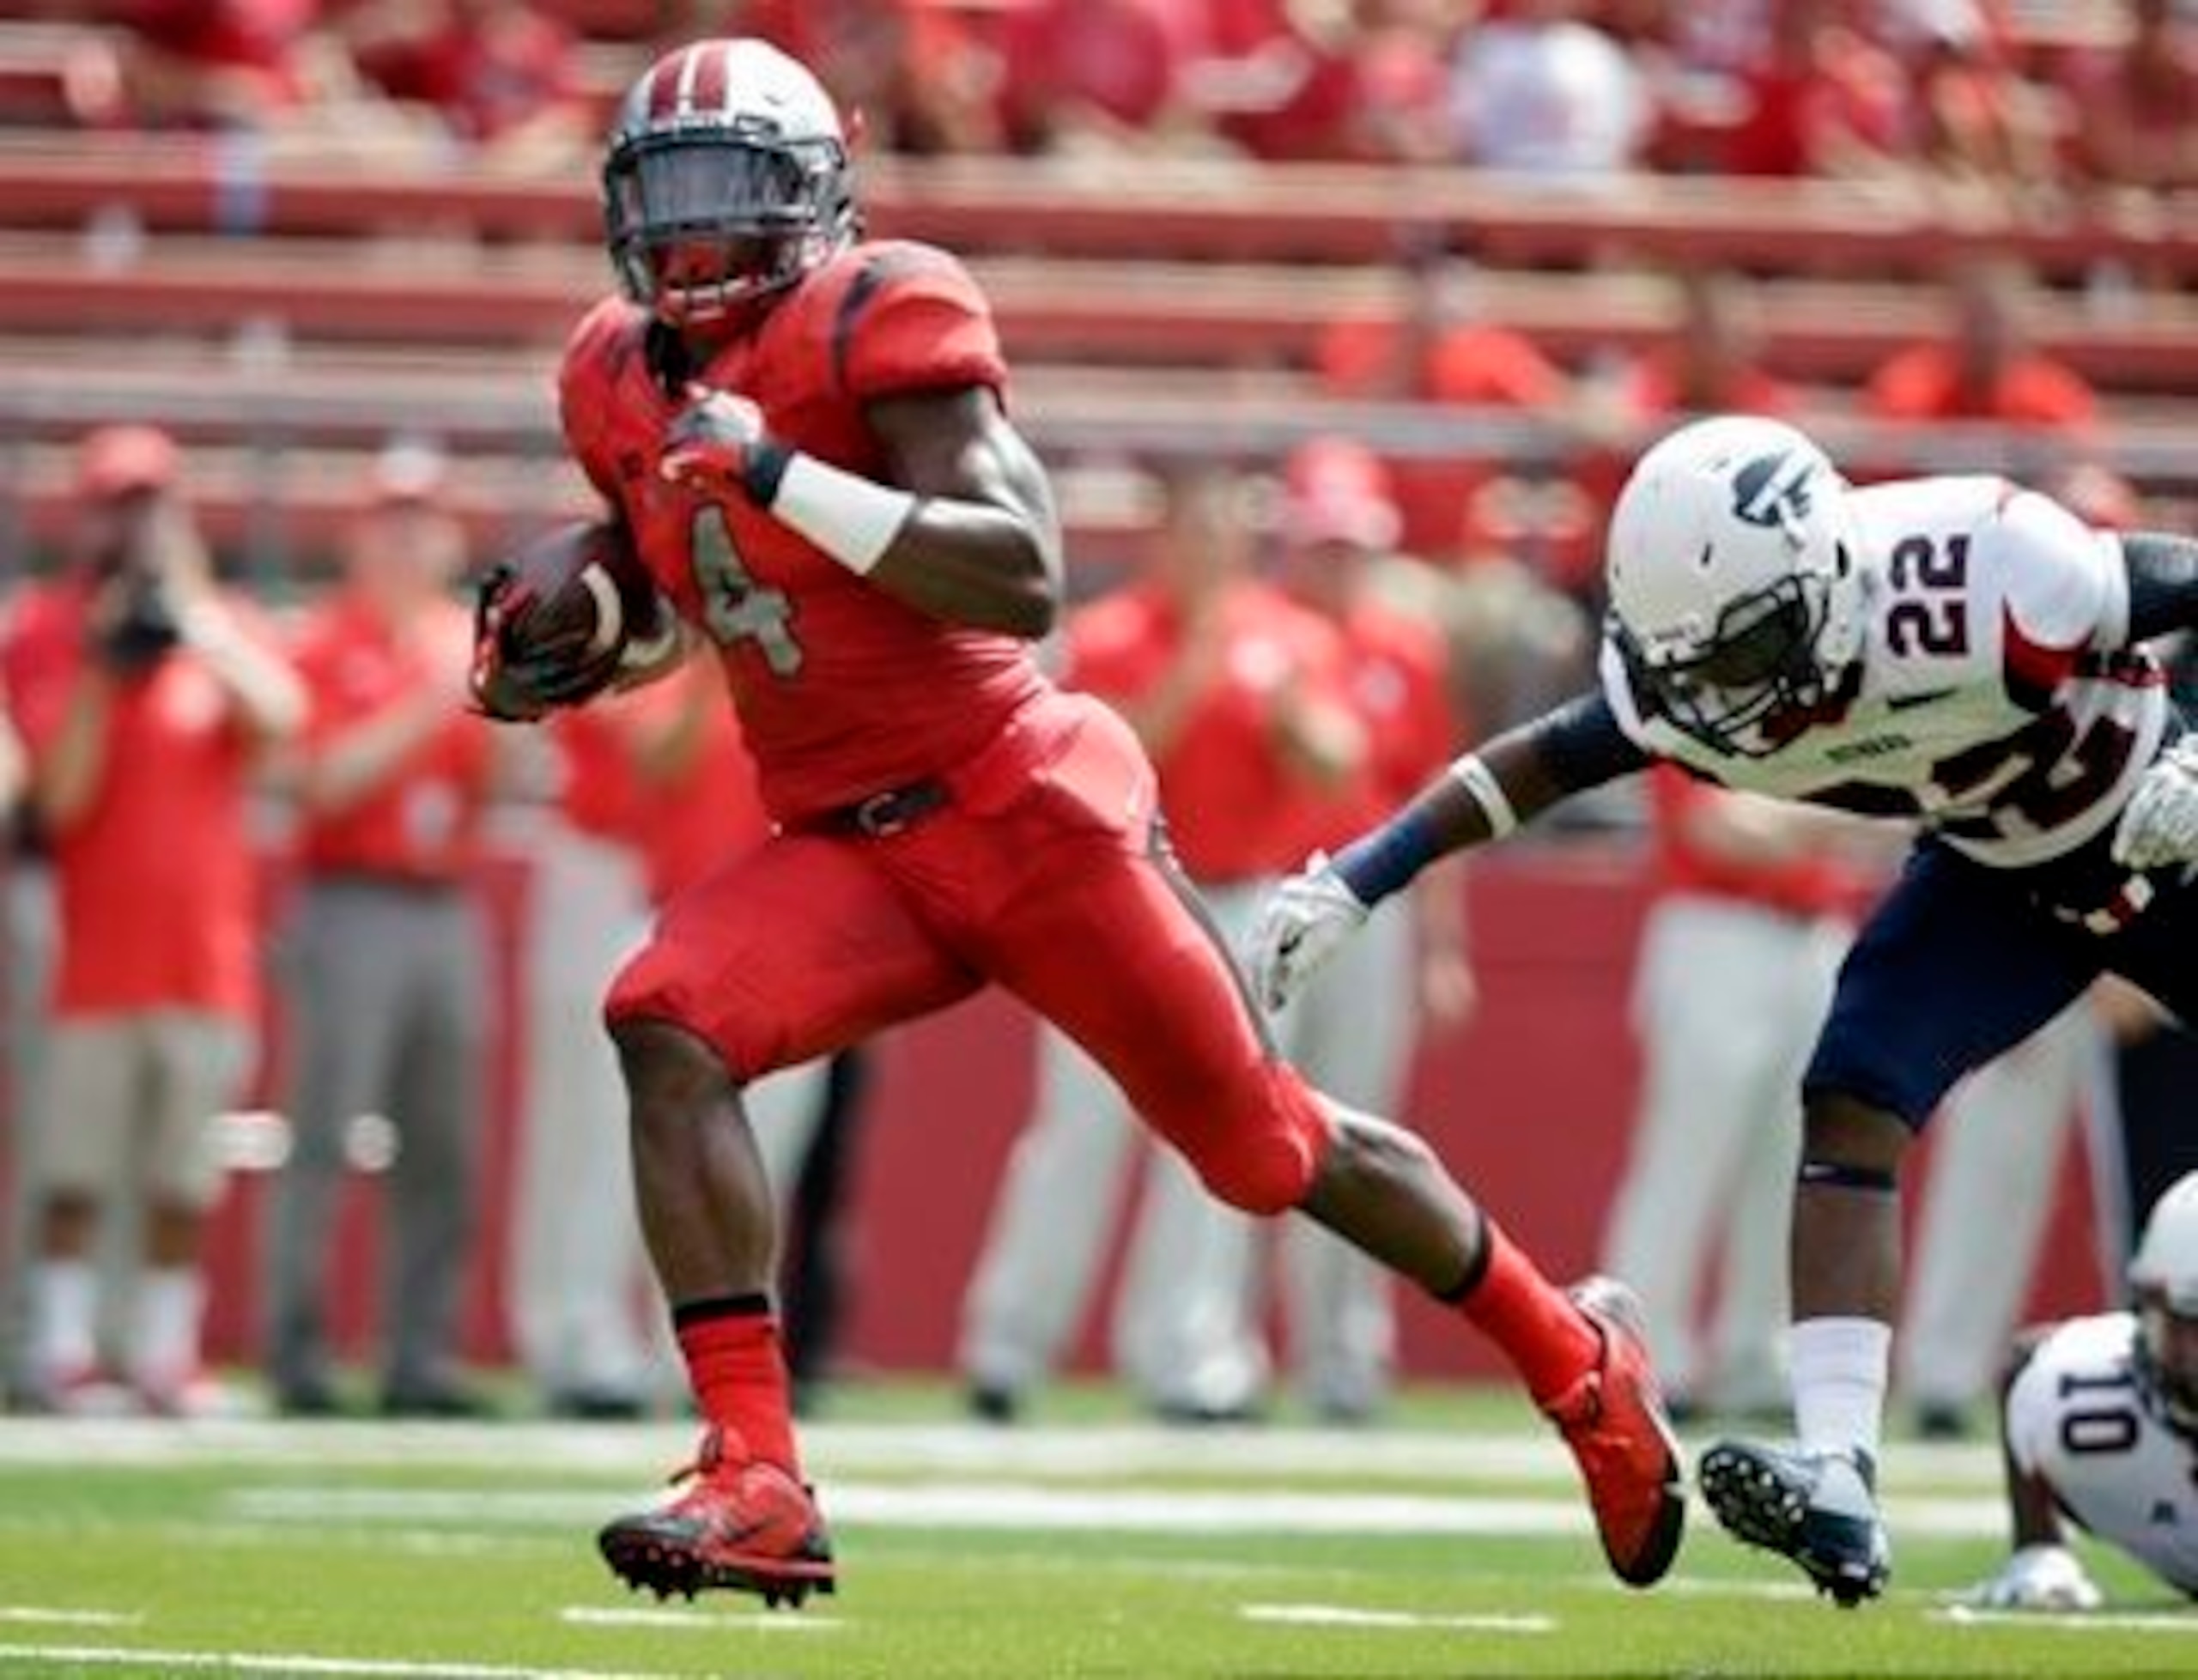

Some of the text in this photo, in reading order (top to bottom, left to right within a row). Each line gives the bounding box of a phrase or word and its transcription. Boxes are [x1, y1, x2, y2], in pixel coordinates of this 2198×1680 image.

[691, 502, 803, 676] 4
[1887, 534, 1970, 657] 22
[2059, 1374, 2139, 1452] 10
